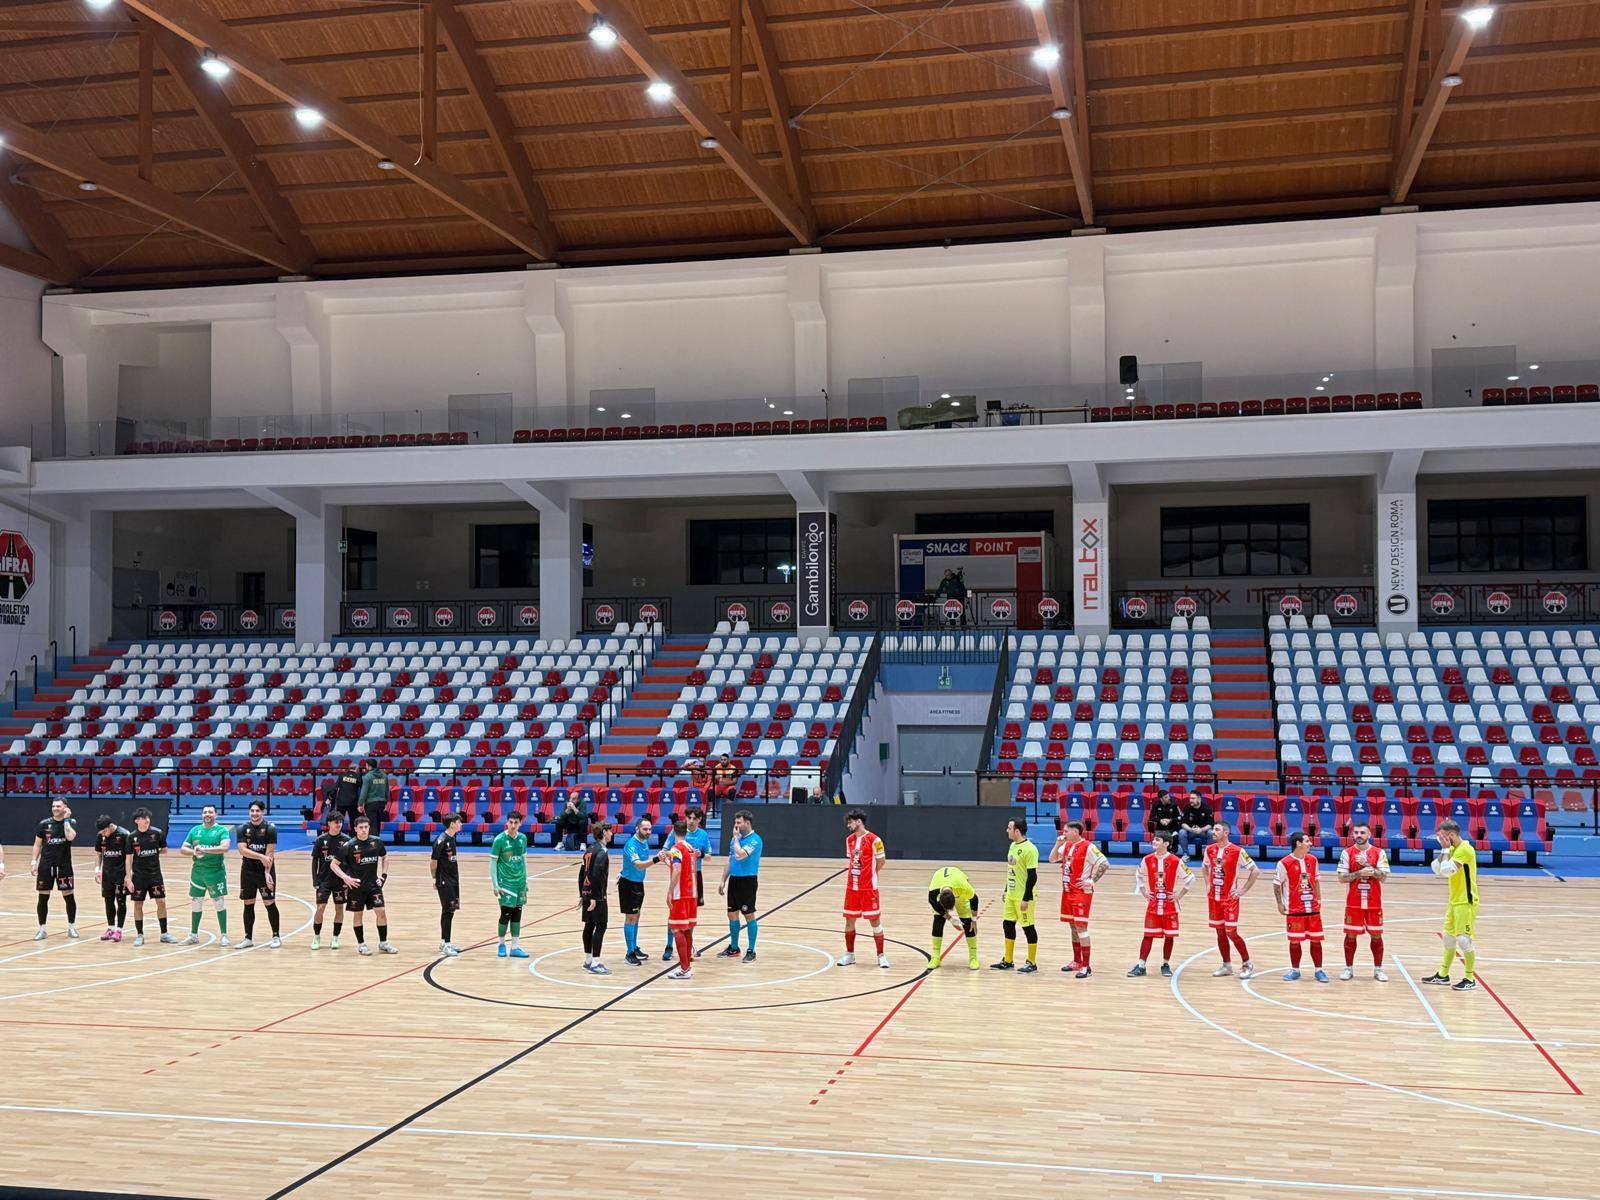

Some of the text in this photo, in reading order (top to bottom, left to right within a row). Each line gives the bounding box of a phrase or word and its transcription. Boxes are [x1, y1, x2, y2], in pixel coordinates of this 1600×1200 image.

[0, 556, 30, 573] IFRA
[805, 522, 824, 616] Gambilongo
[926, 542, 1013, 553] SNACK POINT
[1390, 500, 1400, 590] NEW DESIGN ROMA
